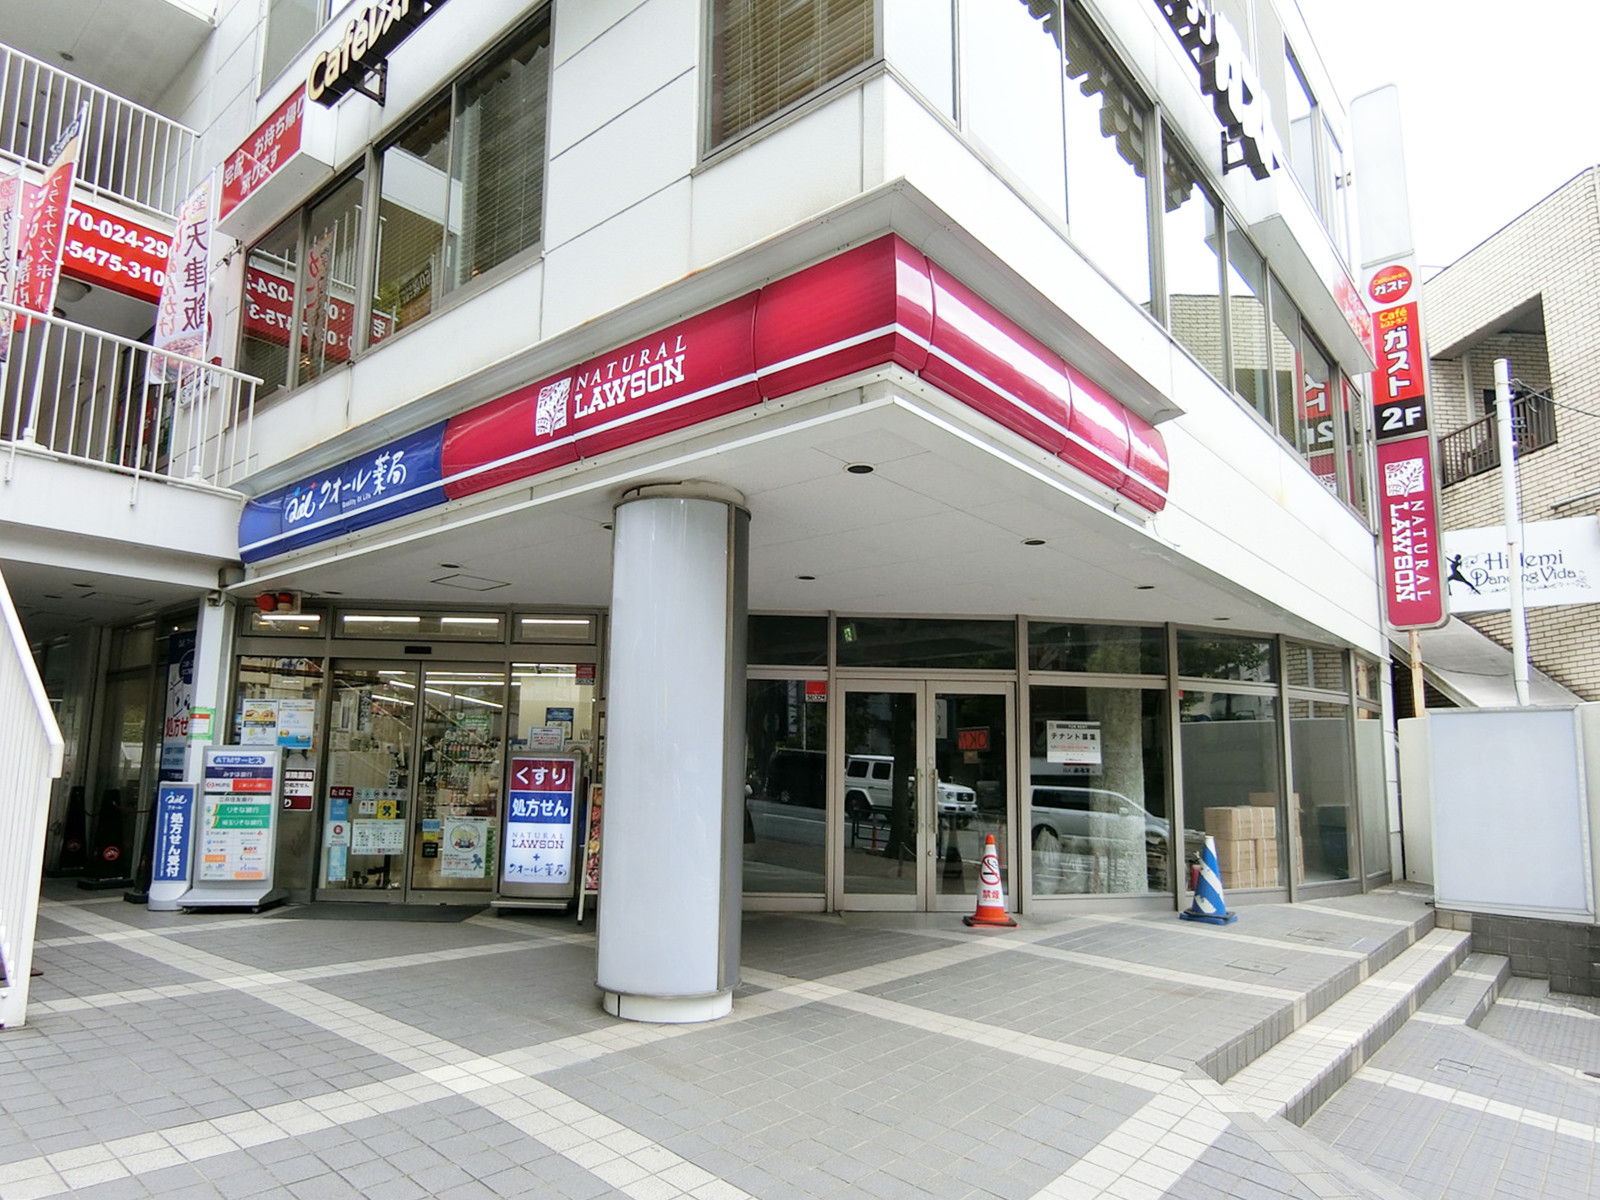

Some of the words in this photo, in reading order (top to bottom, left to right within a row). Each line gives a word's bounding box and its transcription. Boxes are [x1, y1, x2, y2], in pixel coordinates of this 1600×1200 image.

[1374, 279, 1409, 296] ガスト
[1379, 306, 1408, 322] Café
[576, 335, 687, 391] NATURAL
[1384, 325, 1411, 398] ガスト
[574, 353, 685, 419] LAWSON
[1382, 406, 1422, 431] 2F
[319, 450, 406, 510] クオール薬局
[1390, 501, 1416, 602] LAWSON
[1411, 501, 1432, 602] NATURAL
[1470, 568, 1539, 587] Danng
[1540, 566, 1577, 582] Vida
[516, 766, 566, 785] くすり
[331, 788, 352, 796] たばこ
[512, 797, 569, 817] 処方せん
[166, 812, 184, 877] 処方せん受付
[512, 840, 564, 849] LAWSON
[509, 863, 567, 877] クオール薬局
